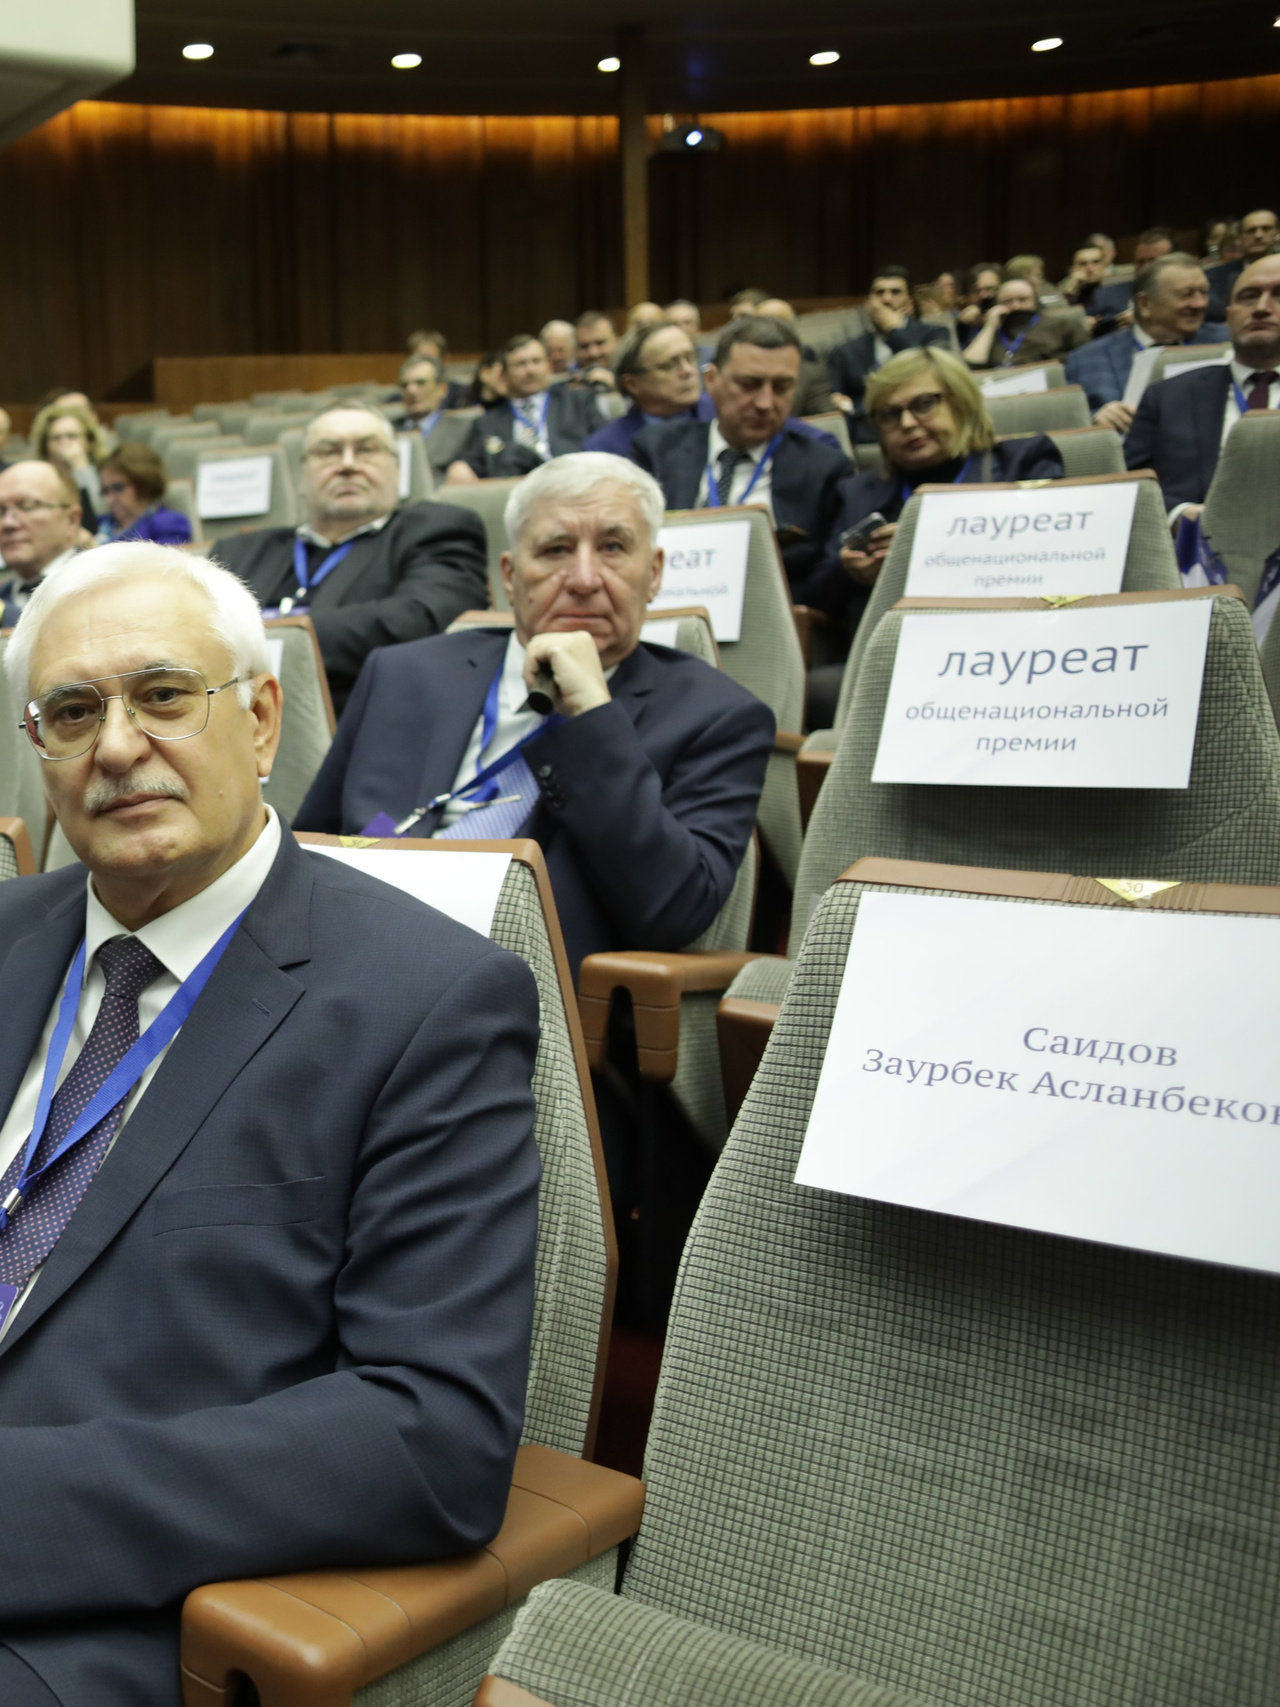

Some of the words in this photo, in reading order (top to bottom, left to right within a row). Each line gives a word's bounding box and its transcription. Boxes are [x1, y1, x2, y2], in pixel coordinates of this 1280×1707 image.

[947, 510, 1094, 539] лауреат
[924, 547, 1107, 569] общенациональной
[973, 572, 1044, 588] премии
[937, 644, 1149, 685] лауреат
[905, 698, 1168, 722] общенациональной
[976, 735, 1076, 755] премии
[1023, 1027, 1178, 1067] Саидов
[862, 1048, 1018, 1092] Заурбек
